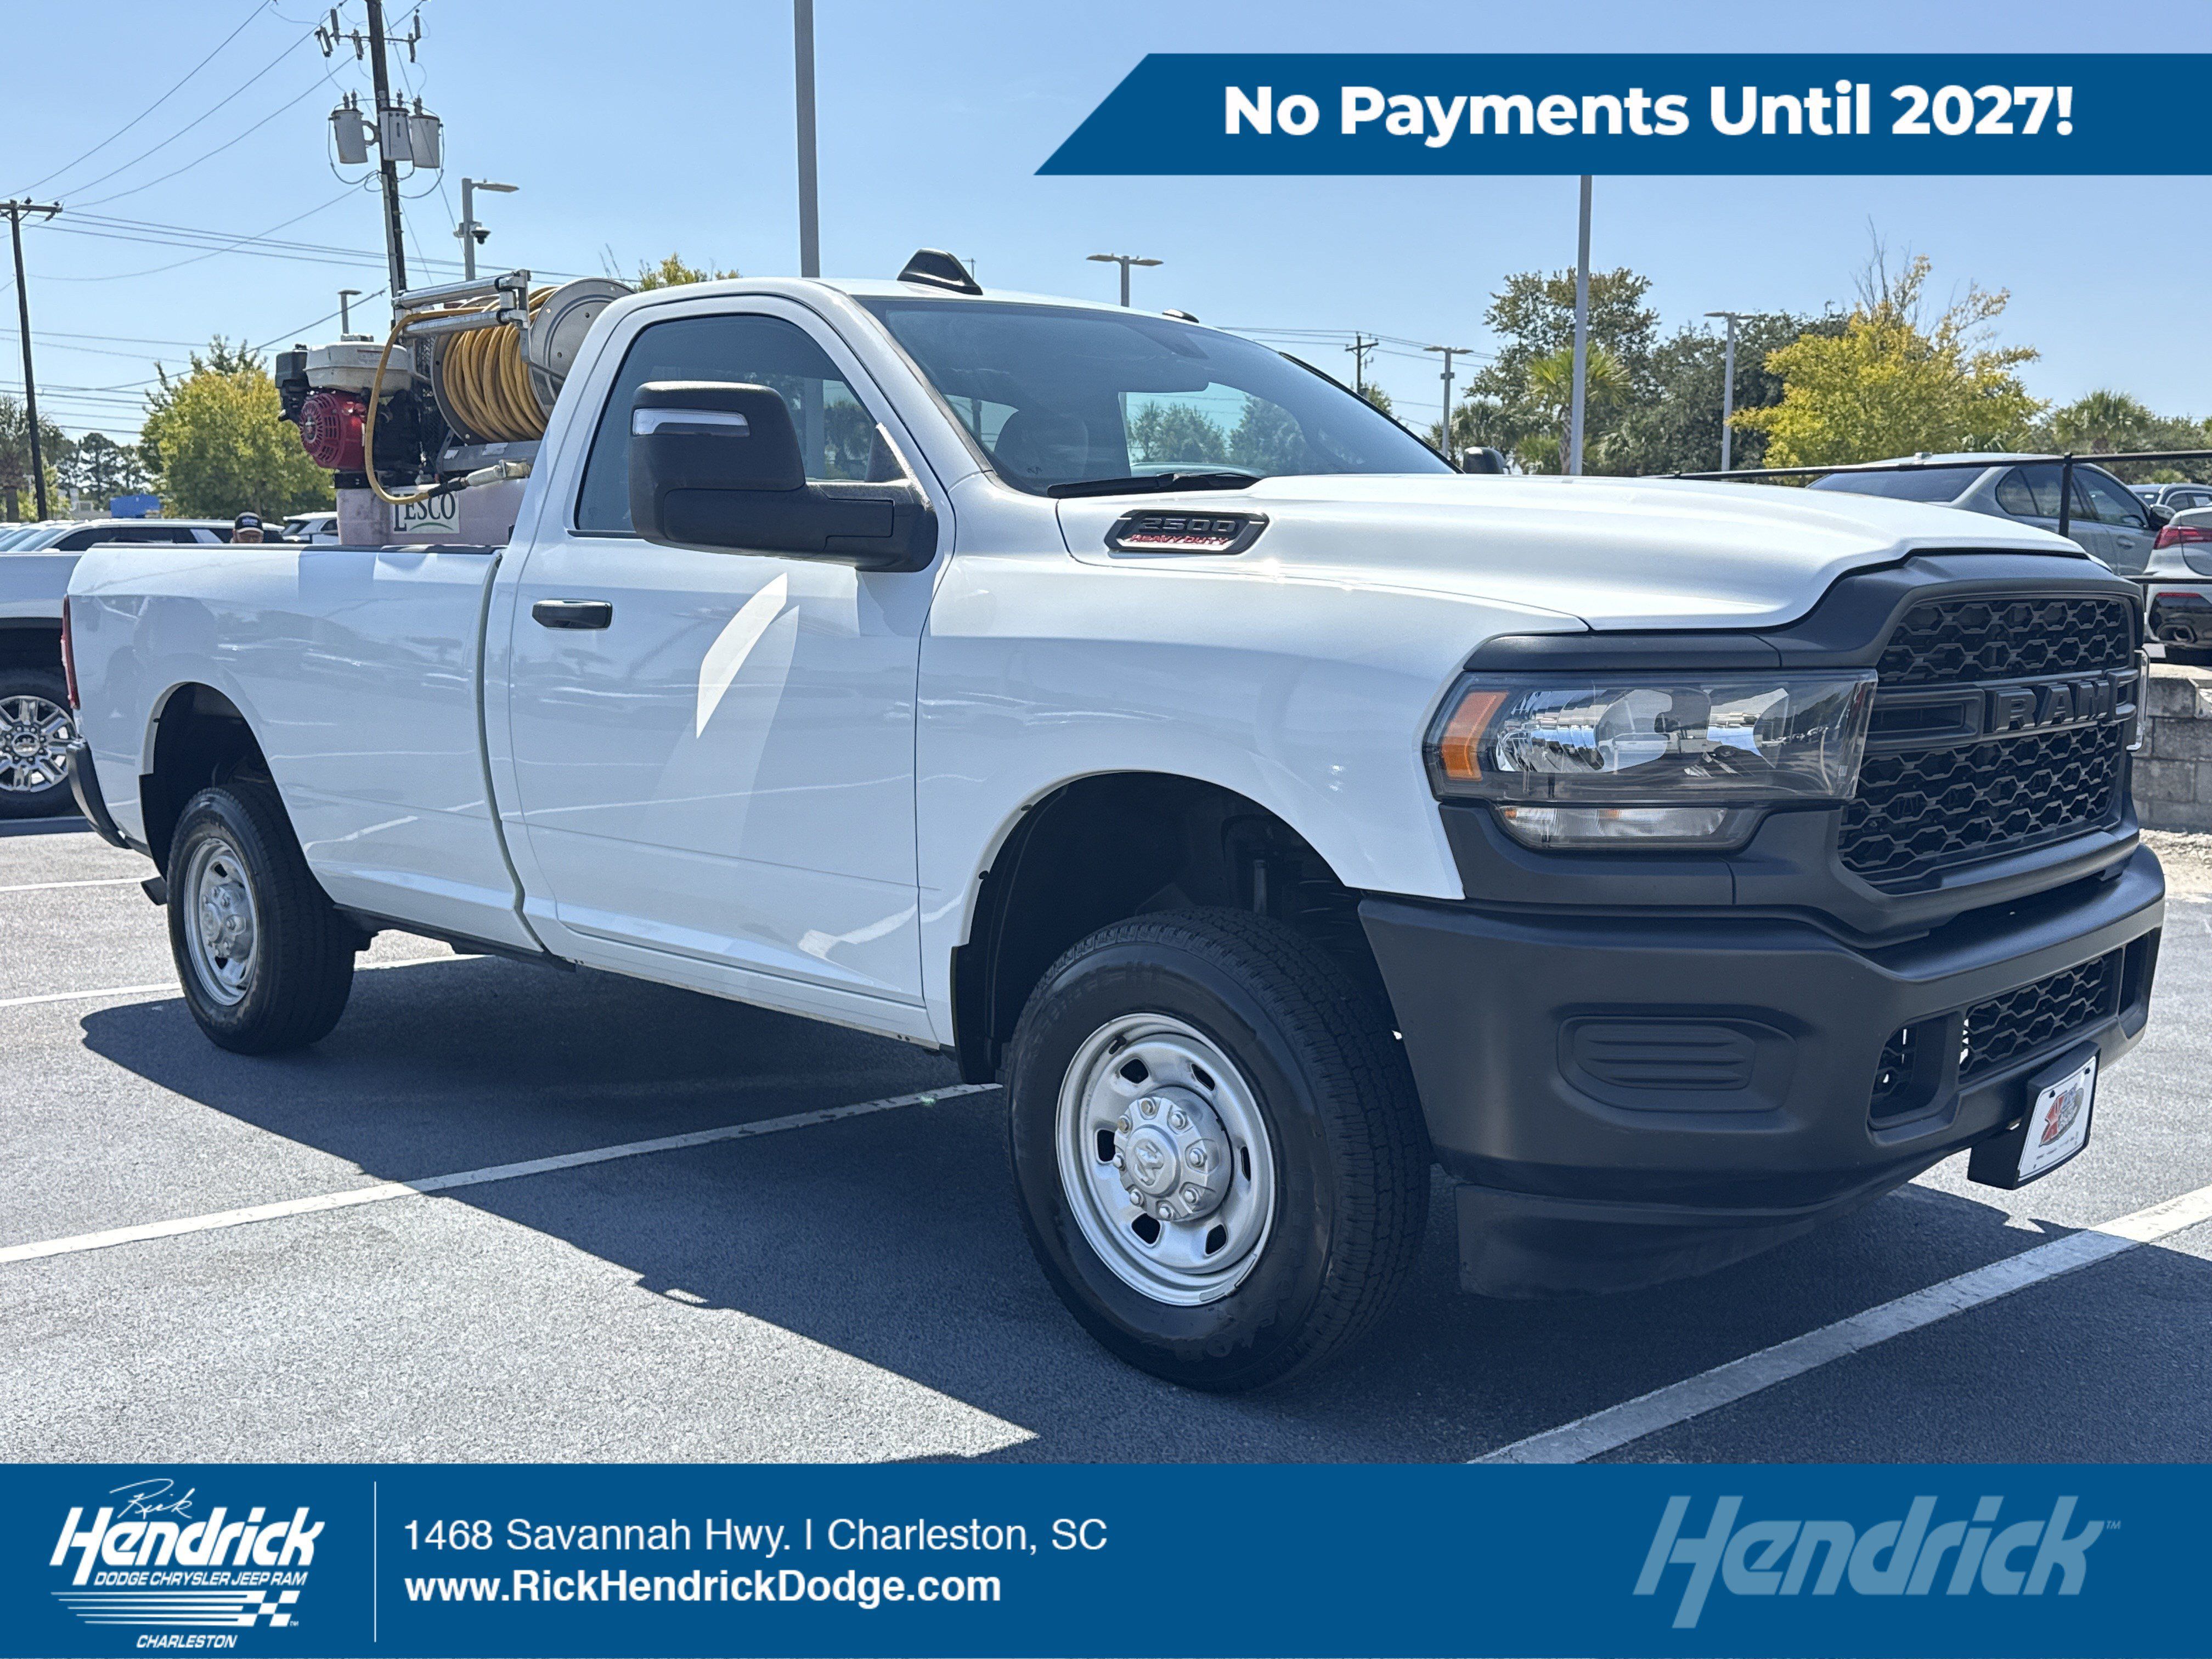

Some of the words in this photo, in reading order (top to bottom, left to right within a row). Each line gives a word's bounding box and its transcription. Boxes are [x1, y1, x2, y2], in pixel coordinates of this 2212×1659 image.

[393, 493, 456, 532] LESCO
[1139, 517, 1237, 533] 2500
[1130, 534, 1182, 543] HEAVY
[1184, 535, 1229, 545] DUTY
[1995, 679, 2111, 733] RAM
